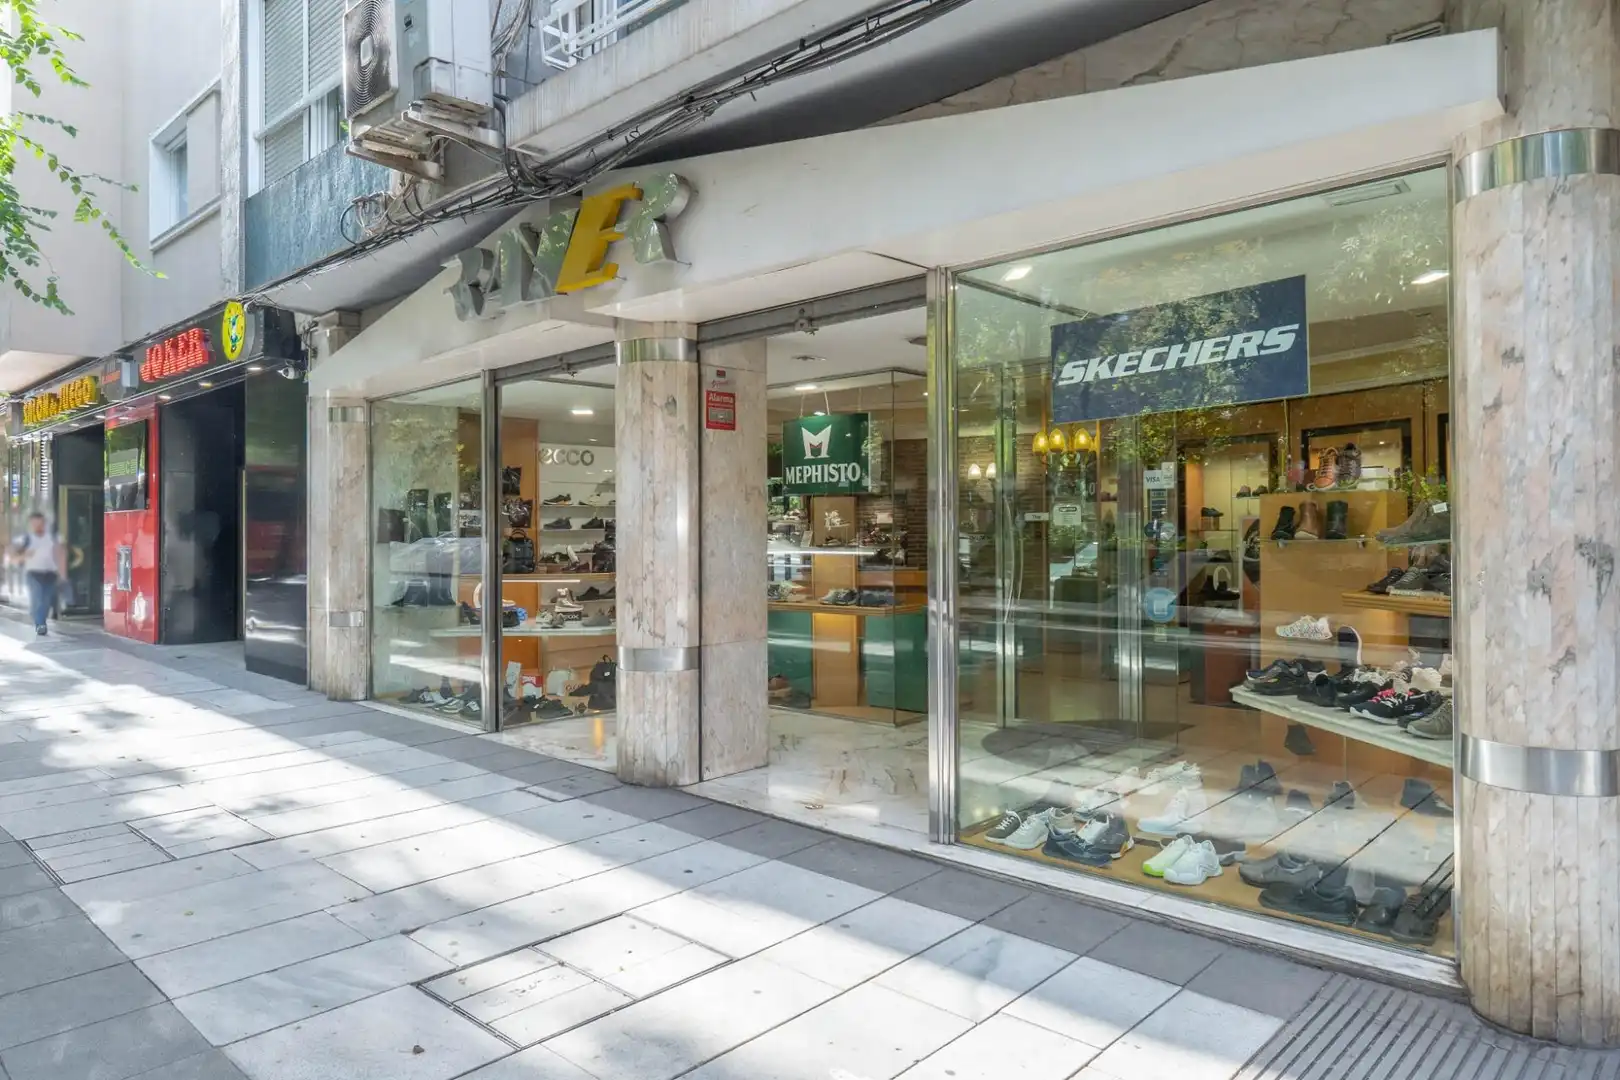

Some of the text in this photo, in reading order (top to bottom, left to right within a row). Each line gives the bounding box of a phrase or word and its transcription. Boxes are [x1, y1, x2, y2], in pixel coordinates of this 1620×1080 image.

[140, 328, 206, 382] JOKER
[1057, 323, 1300, 386] SKECHERS
[708, 392, 733, 403] Alarma
[538, 448, 595, 467] ecco
[785, 462, 861, 485] MEPHISTO
[1145, 476, 1161, 484] VISA
